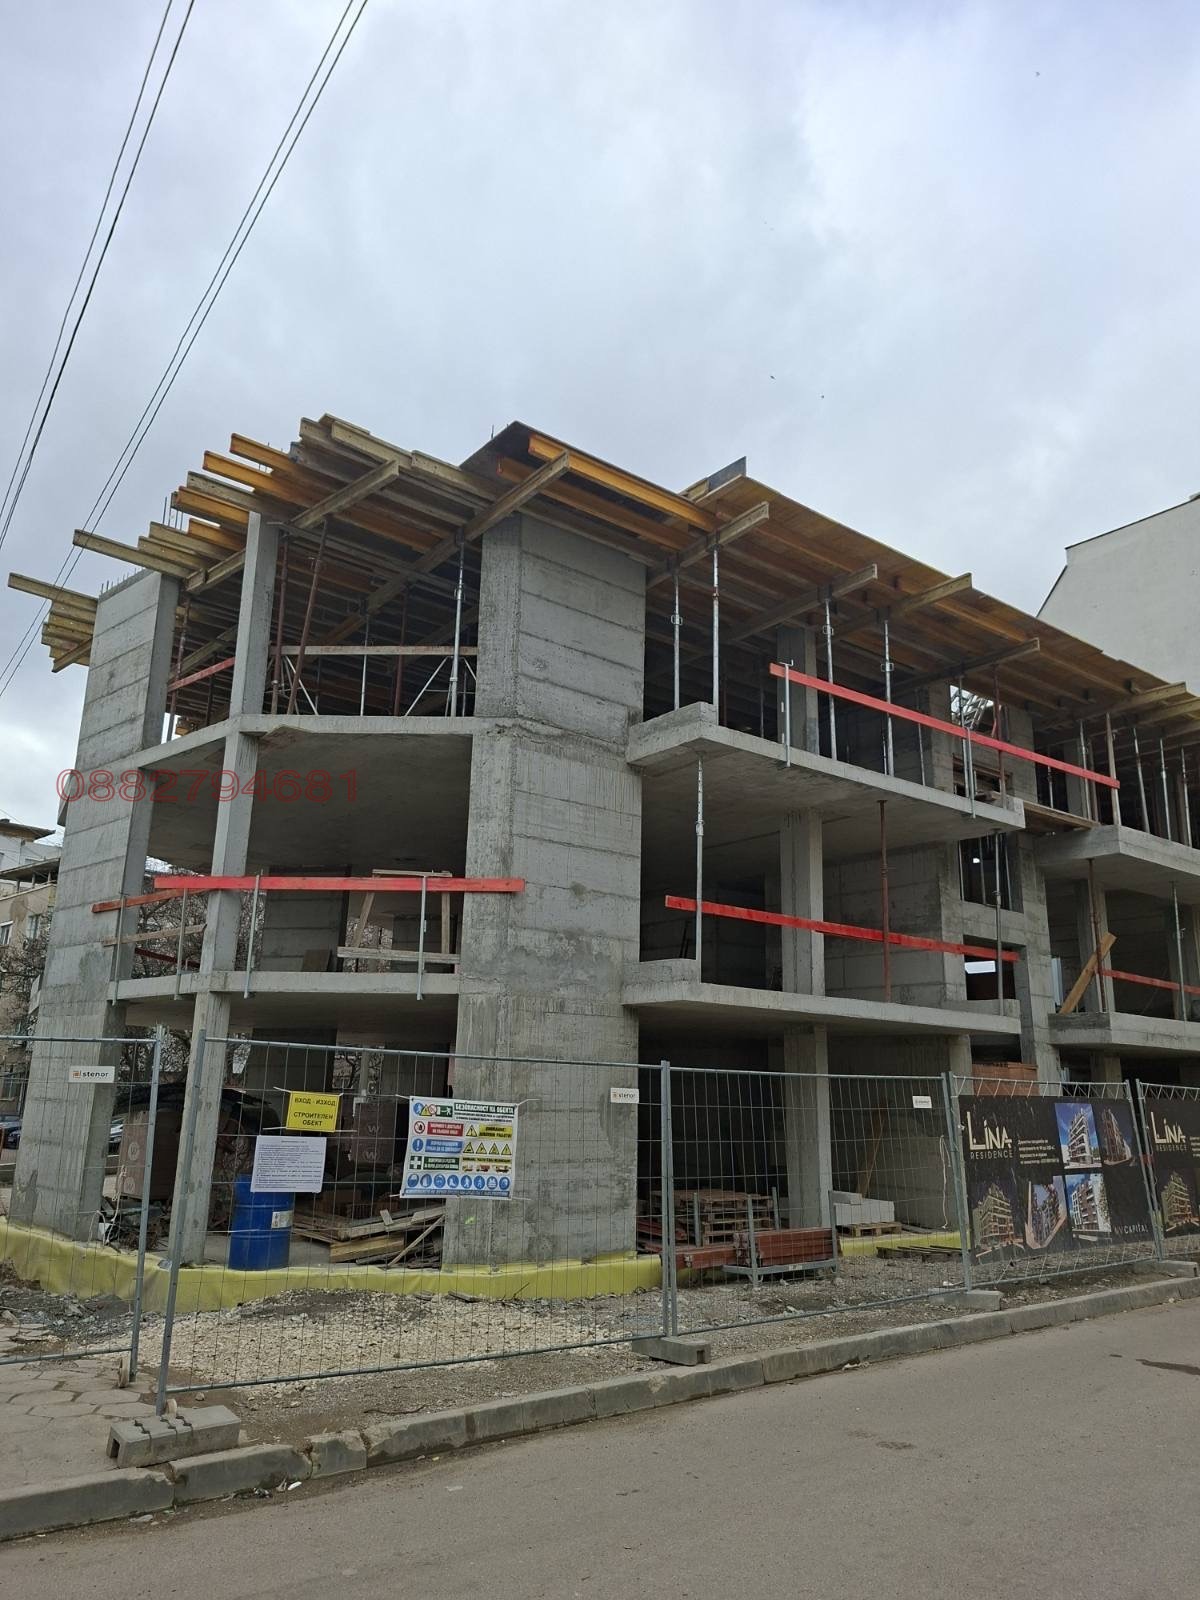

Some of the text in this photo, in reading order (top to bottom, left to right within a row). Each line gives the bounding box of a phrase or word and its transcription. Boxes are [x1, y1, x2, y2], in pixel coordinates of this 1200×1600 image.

[294, 1097, 312, 1105] ВХОД
[315, 1099, 337, 1107] ИЗХОД
[302, 1119, 323, 1127] ОБЕКТ
[970, 1150, 1014, 1160] RESIDENCE
